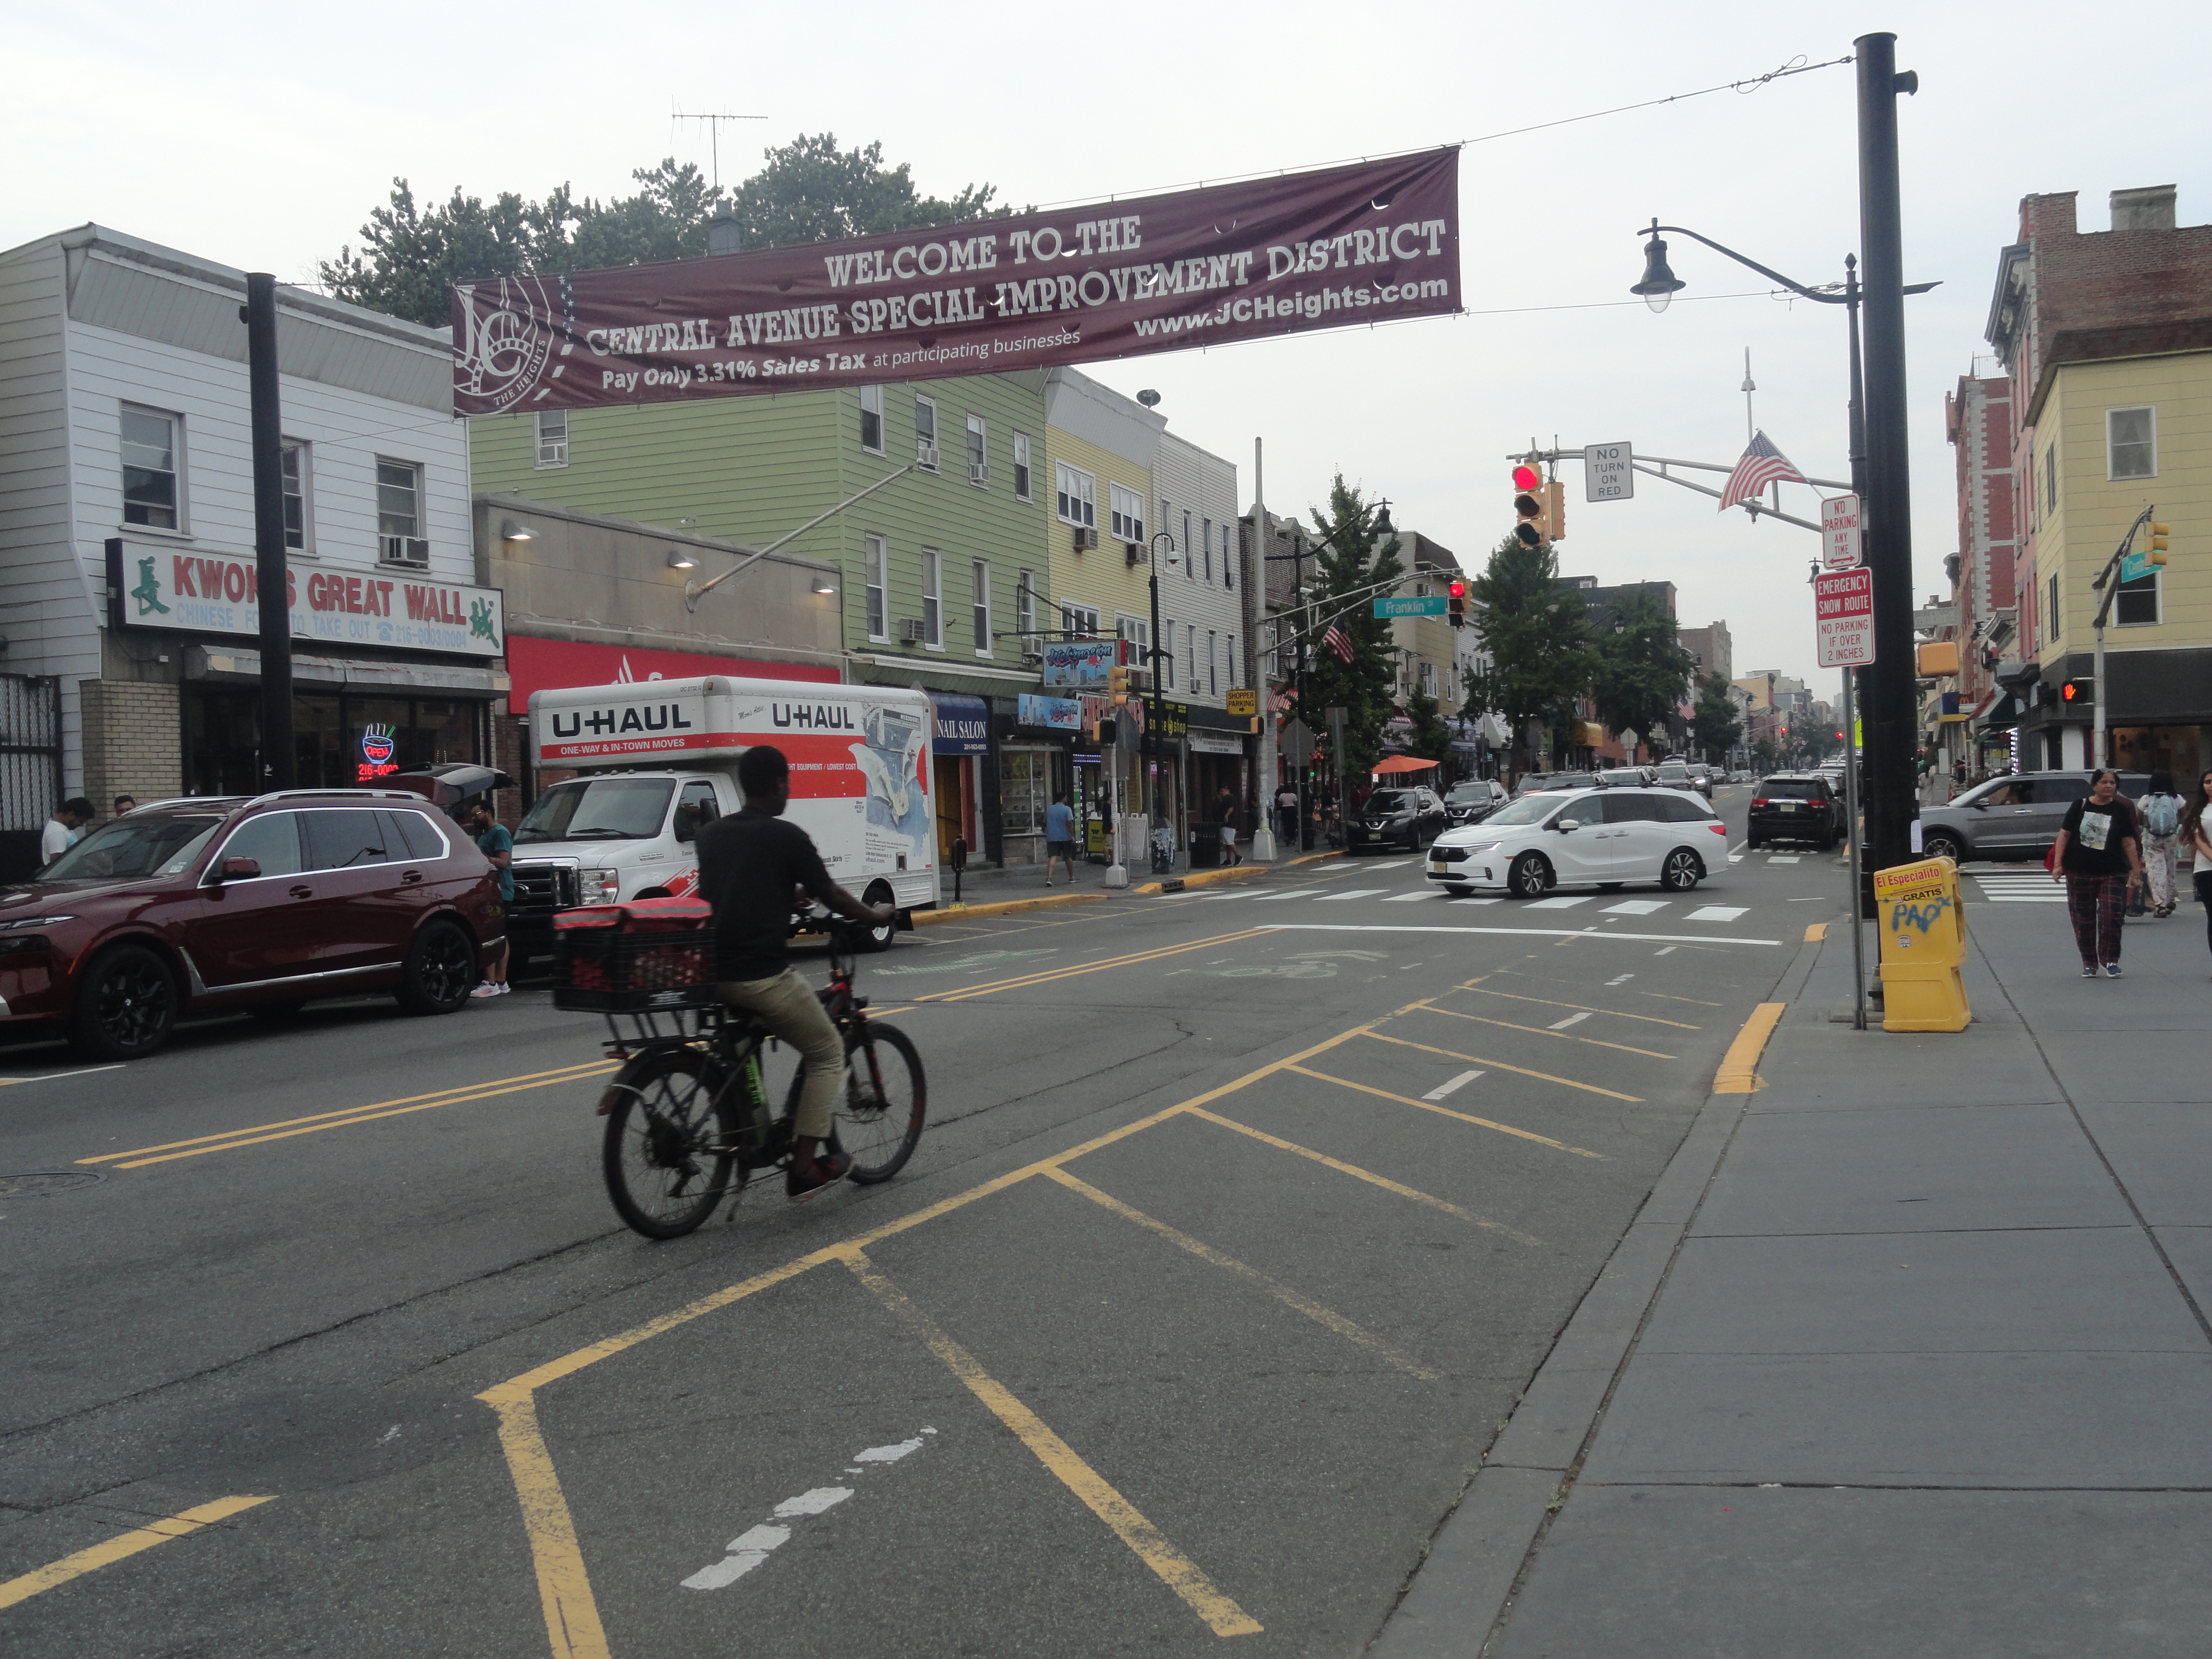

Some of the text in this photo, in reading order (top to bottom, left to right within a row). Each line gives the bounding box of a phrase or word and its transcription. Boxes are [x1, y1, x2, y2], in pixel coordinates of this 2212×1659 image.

[824, 215, 1141, 287] WELCOME TO THE
[586, 219, 1446, 356] CENTRAL AVENUE SPECIAL IMPROVEMENT DISTRICT
[1134, 279, 1447, 337] www.JCHeights.com
[516, 339, 546, 392] HEIGHTS
[603, 331, 1080, 393] Pay Only 3.31% Sales Tax at participating businesses
[493, 389, 516, 406] THE
[1597, 448, 1619, 460] NO
[1594, 462, 1624, 473] TURN
[1601, 475, 1617, 484] ON
[1599, 486, 1621, 496] RED
[1834, 500, 1845, 515] NO
[1825, 515, 1856, 532] PARKING
[1834, 532, 1847, 544] ANY
[1834, 544, 1849, 556] TIME
[173, 555, 467, 625] KWOKS GREAT WALL
[1818, 575, 1867, 596] EMERGENCY
[1386, 601, 1424, 613] Franklin
[1819, 595, 1869, 615] SNOW ROUTE
[177, 603, 234, 628] CHINESE
[290, 613, 304, 632] TO
[313, 616, 342, 637] TAKE
[349, 619, 371, 639] OUT
[1822, 619, 1868, 635] NO PARKING
[1829, 634, 1861, 647] IF OVER
[1828, 647, 1863, 661] 2 INCHES
[1228, 699, 1254, 708] PARKING
[553, 704, 691, 737] U-HAUL
[772, 703, 854, 729] U-HAUL
[937, 720, 986, 738] NAIL SALON
[1174, 719, 1186, 734] shop
[366, 746, 389, 757] OPEN
[561, 738, 685, 755] ONE-WAY & IN-TOWN MOVES
[1876, 877, 1886, 888] El
[1888, 868, 1939, 886] Especialito
[1903, 889, 1942, 901] GRATIS
